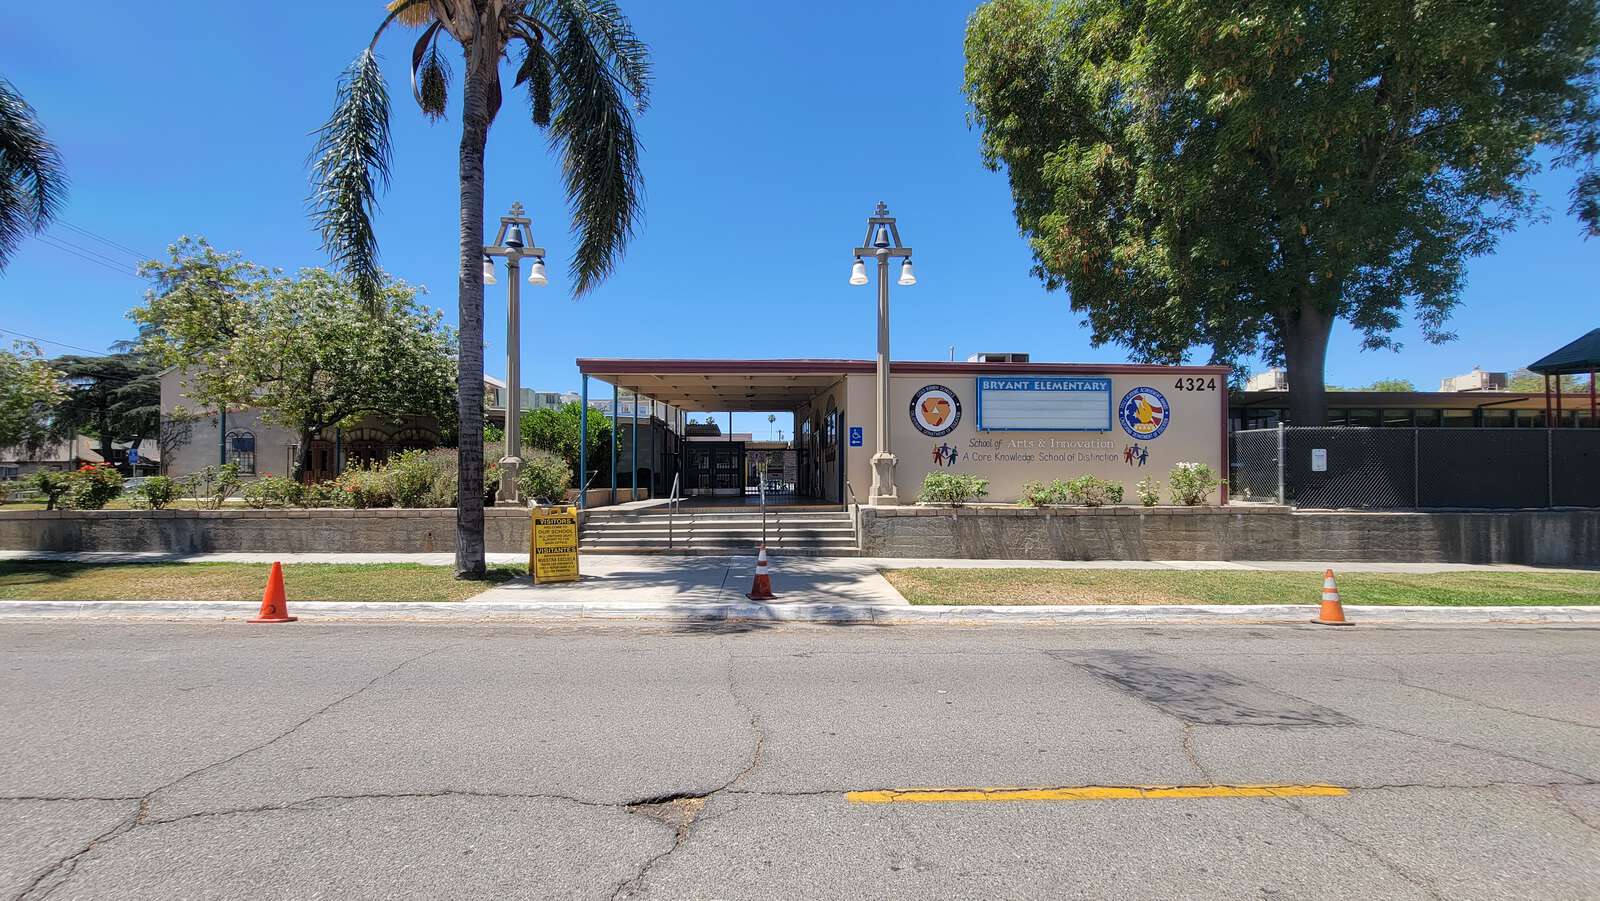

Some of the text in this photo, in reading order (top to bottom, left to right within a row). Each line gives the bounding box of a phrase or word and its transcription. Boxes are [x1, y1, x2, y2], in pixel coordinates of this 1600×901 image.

[982, 381, 1107, 391] BRYANT ELEMENTARY
[1174, 378, 1217, 391] 4324
[969, 438, 1114, 450] School of Arts & Innovation
[962, 452, 1119, 464] A Core Knowledge School of Distinction
